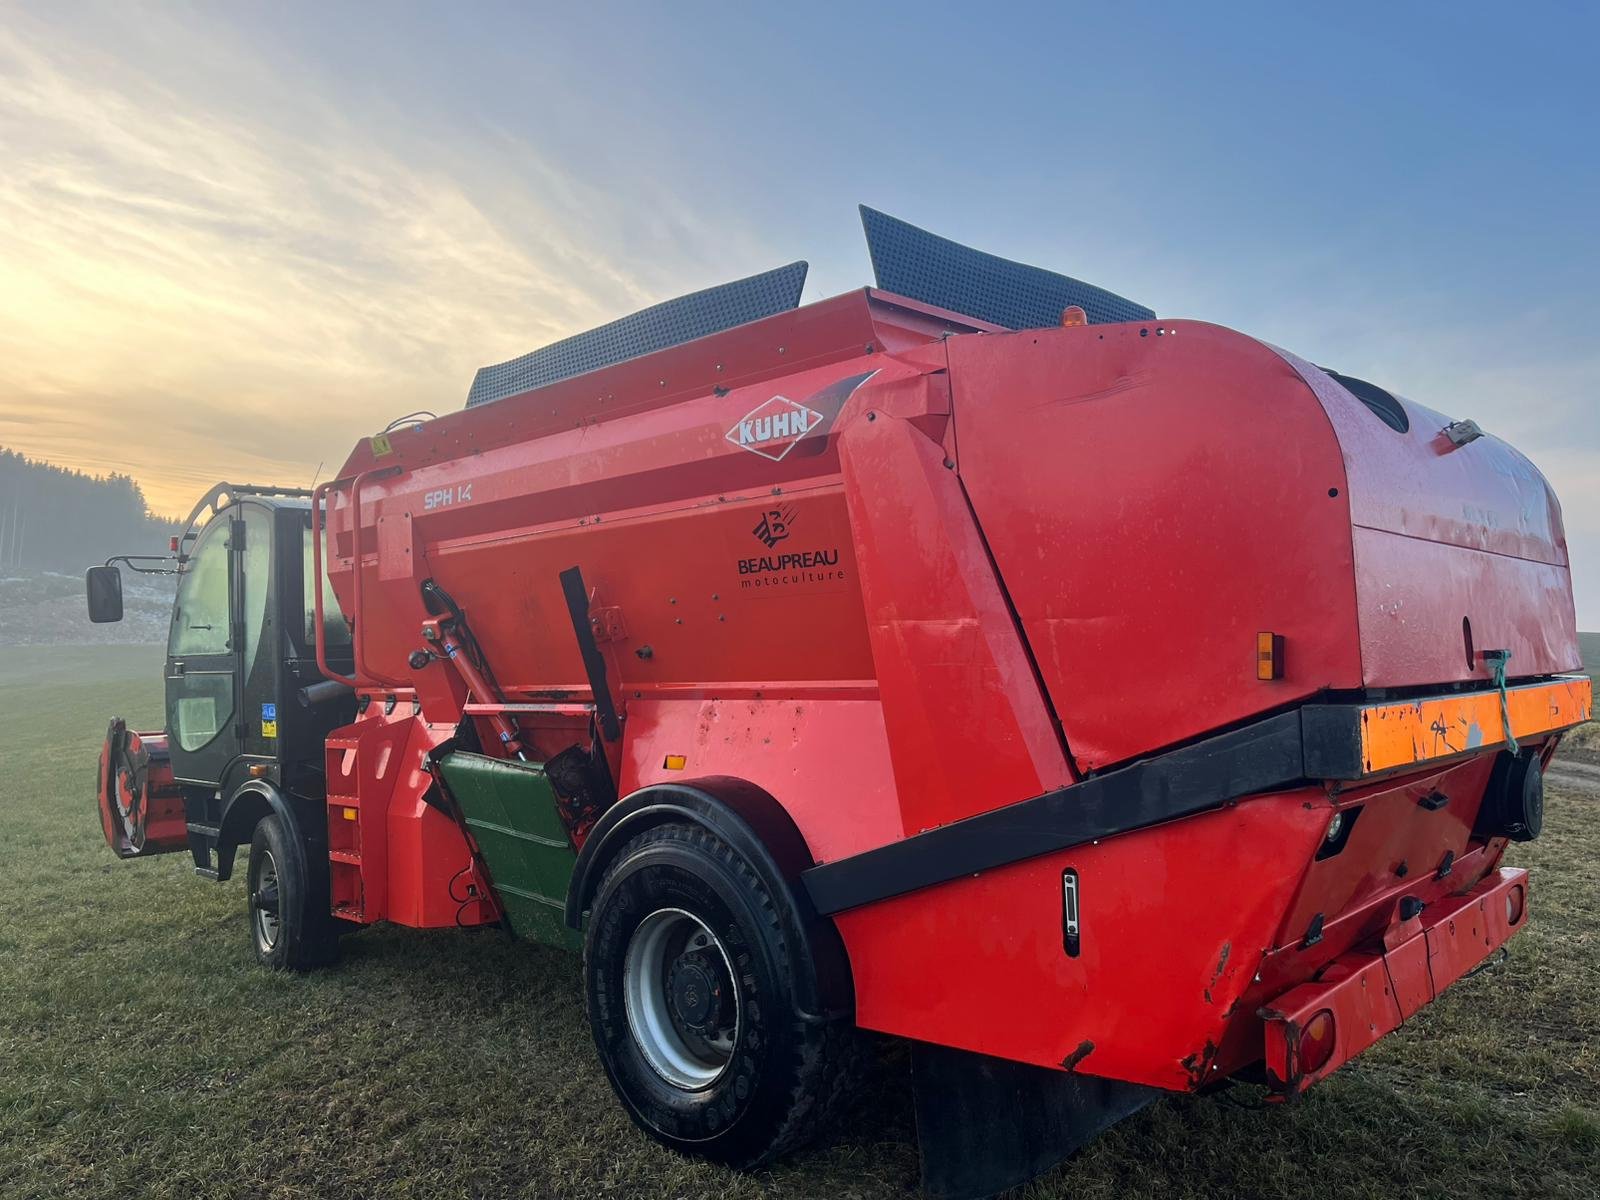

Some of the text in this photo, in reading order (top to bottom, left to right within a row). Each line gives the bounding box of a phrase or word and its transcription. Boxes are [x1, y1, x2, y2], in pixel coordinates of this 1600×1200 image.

[739, 407, 808, 445] KUHN
[424, 483, 472, 510] SPH 14
[738, 549, 838, 575] BEAUPREAU
[741, 570, 844, 588] motoculture
